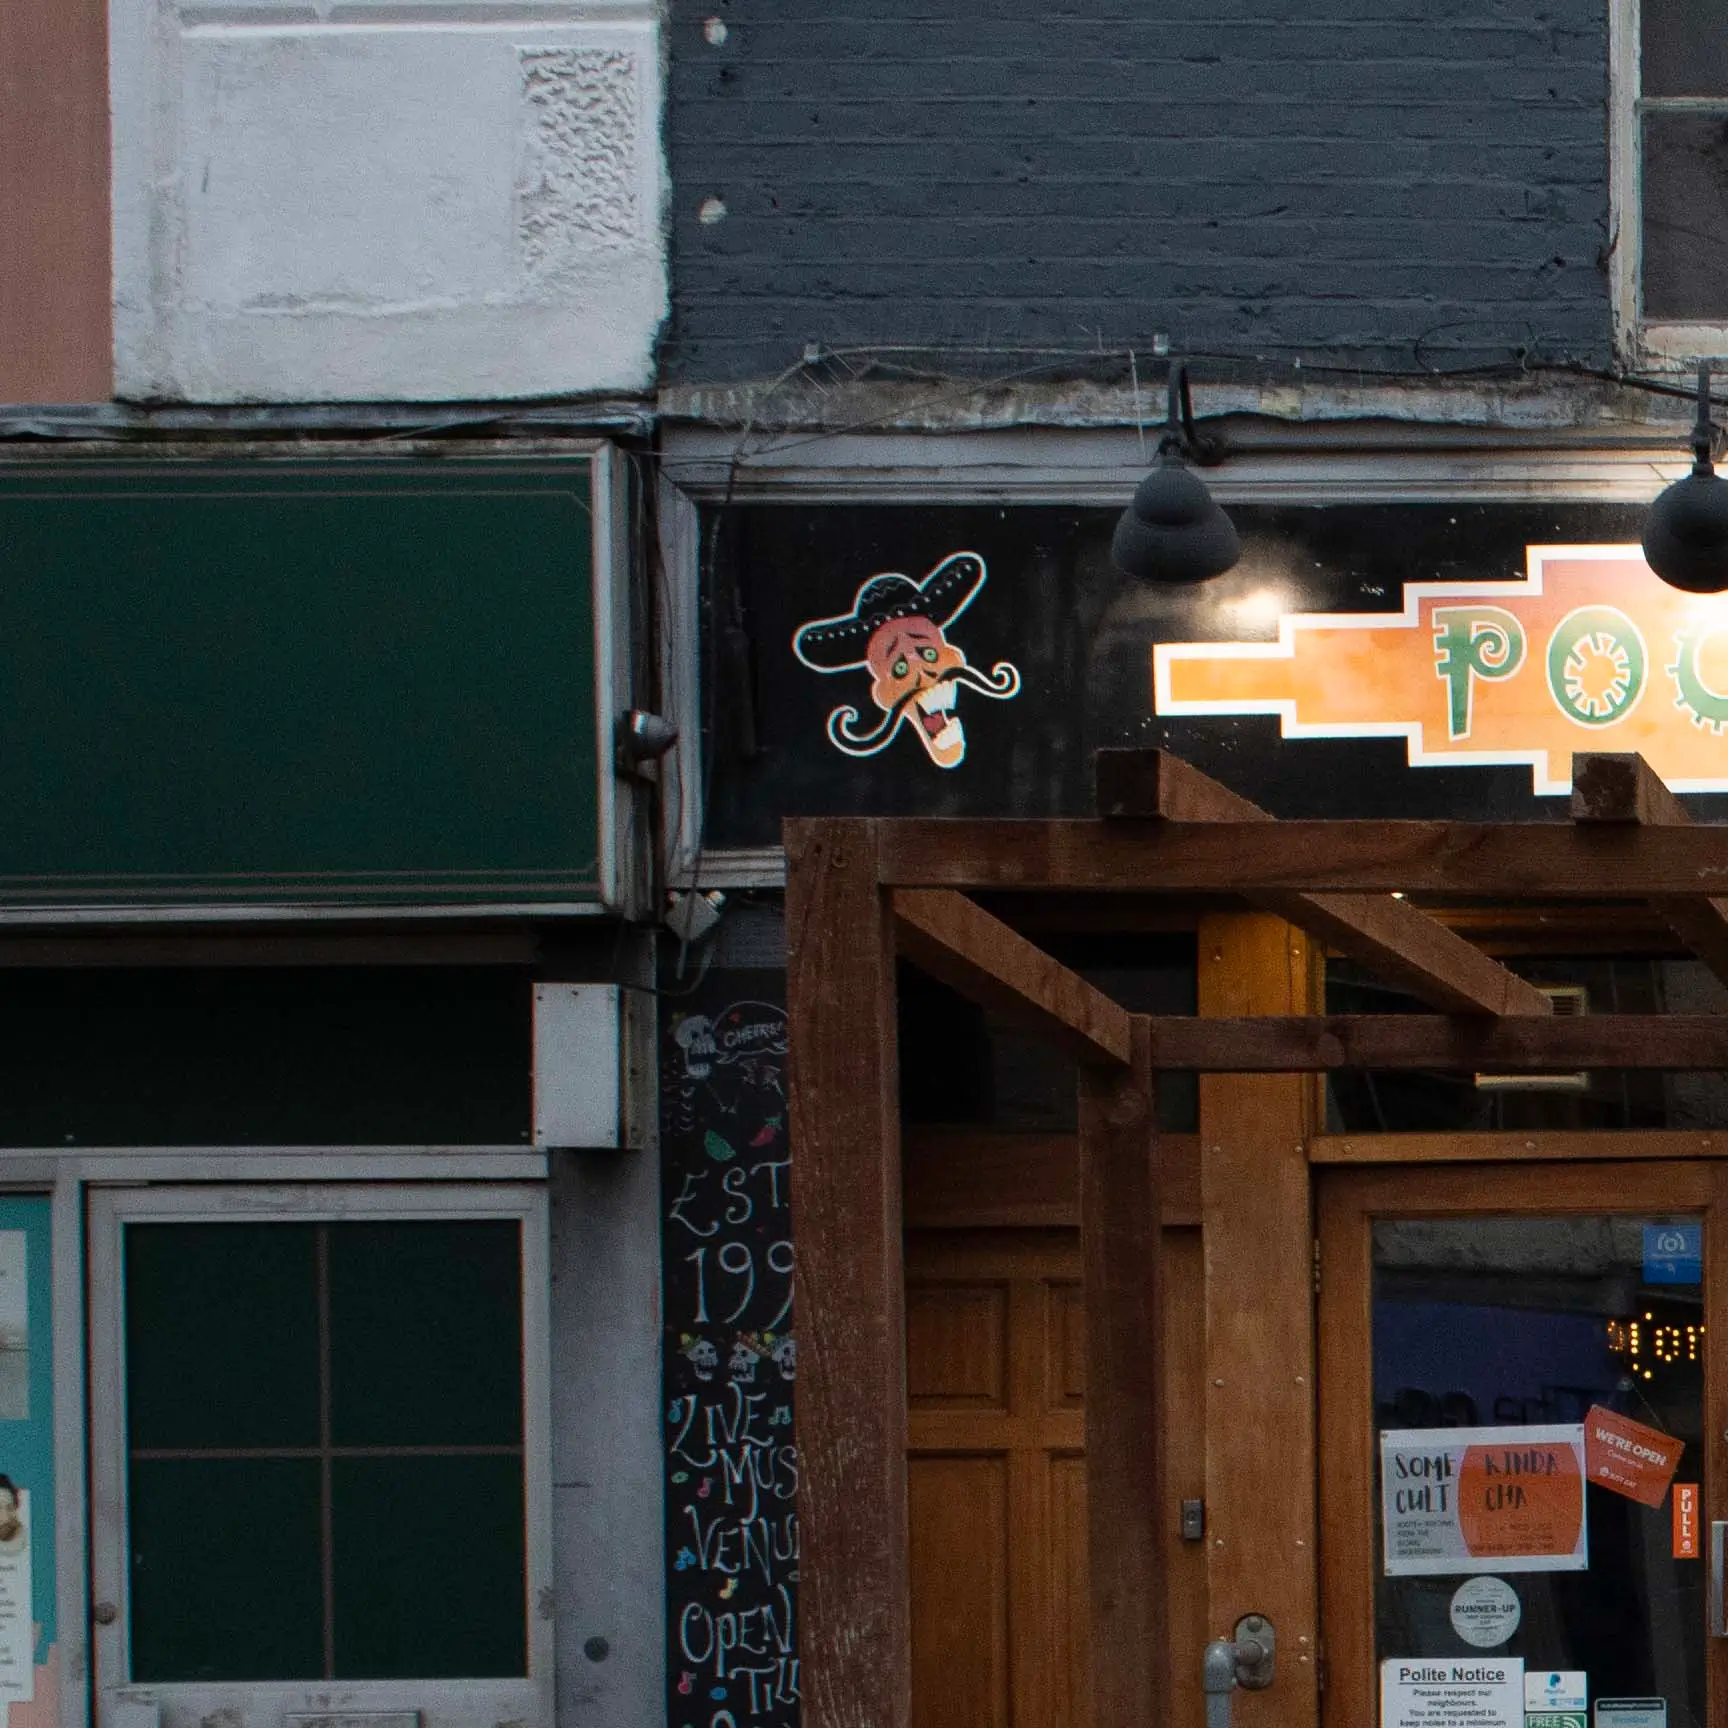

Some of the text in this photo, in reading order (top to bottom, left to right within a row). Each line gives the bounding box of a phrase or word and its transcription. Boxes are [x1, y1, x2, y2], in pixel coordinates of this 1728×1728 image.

[684, 1240, 796, 1331] 199
[669, 1381, 775, 1468] LIVE
[1395, 1452, 1457, 1481] SOME
[1632, 1443, 1668, 1467] OPEN
[718, 1444, 800, 1525] MUS
[1395, 1484, 1450, 1514] CULT
[1681, 1488, 1693, 1537] PULL
[679, 1583, 793, 1679] OPEN
[1399, 1666, 1505, 1682] Polite Notice
[1529, 1715, 1560, 1727] FREE
